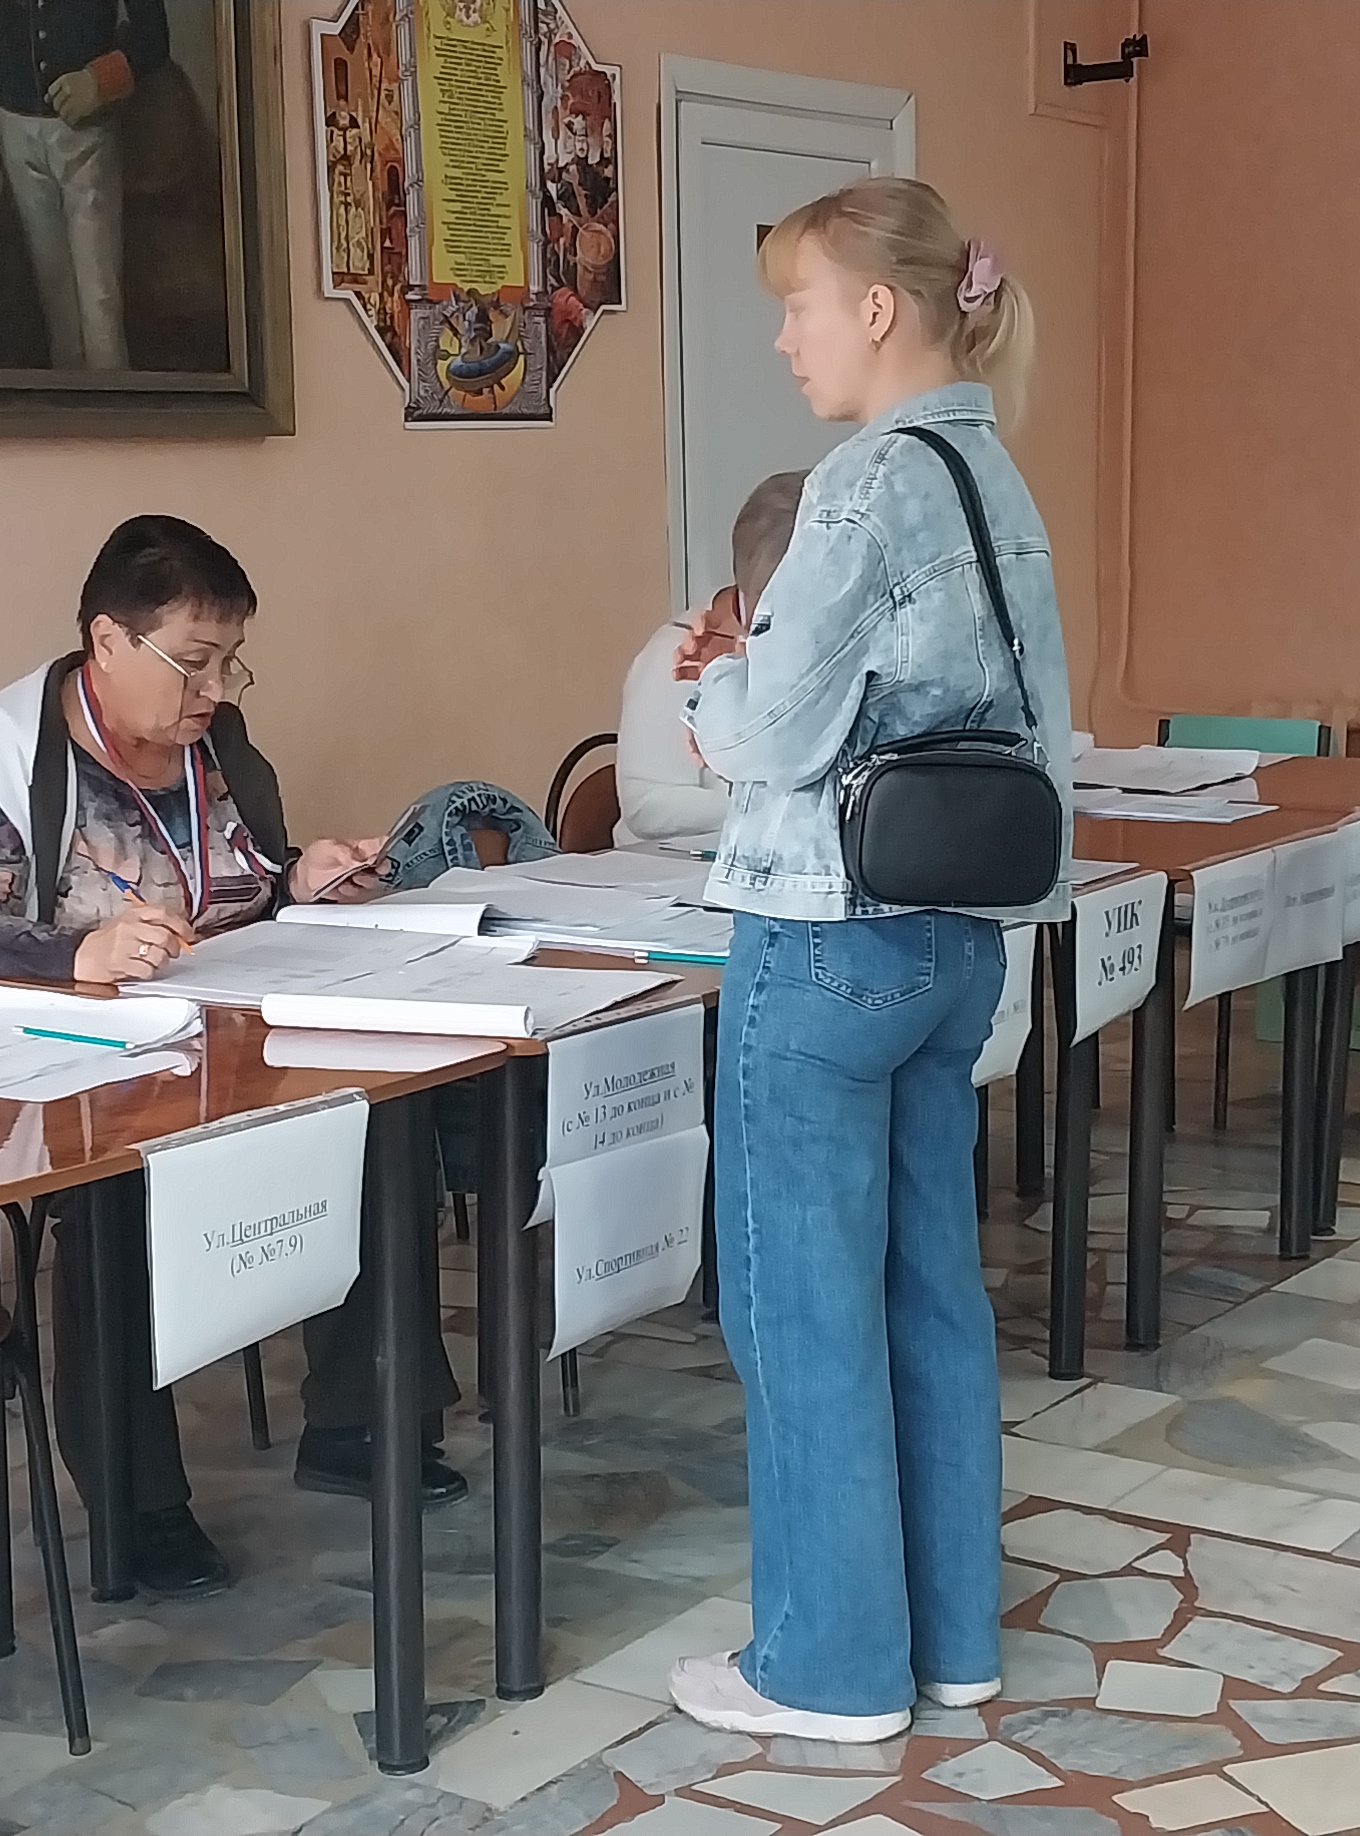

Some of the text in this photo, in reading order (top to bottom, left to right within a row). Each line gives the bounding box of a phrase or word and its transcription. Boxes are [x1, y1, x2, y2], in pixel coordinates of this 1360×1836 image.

[1103, 899, 1143, 938] УИК
[1097, 943, 1143, 987] № 493
[576, 1110, 591, 1130] №
[595, 1104, 607, 1124] 13
[594, 1131, 607, 1150] 14
